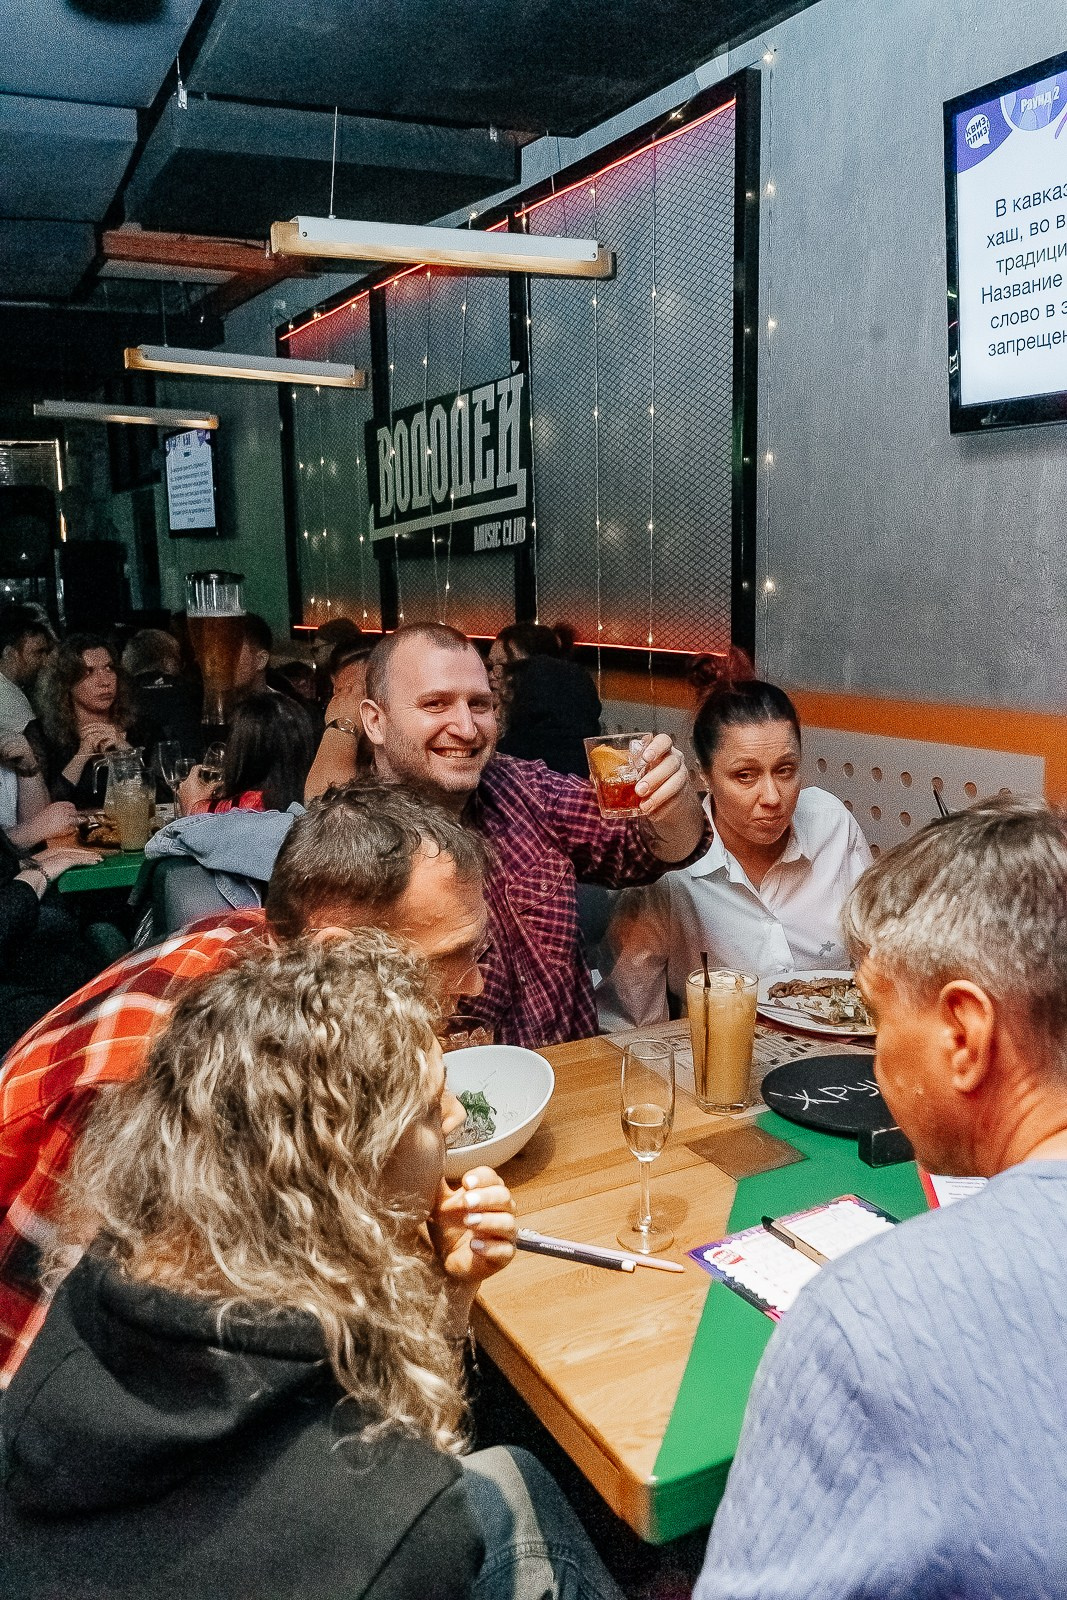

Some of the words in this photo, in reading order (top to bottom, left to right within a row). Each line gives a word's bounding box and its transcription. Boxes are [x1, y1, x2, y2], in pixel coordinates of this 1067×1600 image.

[1052, 85, 1060, 101] 2
[966, 116, 987, 138] КВИЗ
[995, 198, 1007, 218] В
[986, 227, 1023, 249] хаш,
[1029, 218, 1050, 237] во
[995, 242, 1067, 276] традици
[981, 273, 1063, 305] Название
[990, 307, 1040, 329] слово
[1046, 303, 1056, 318] в
[376, 360, 526, 518] ВОДОЛЕЙ
[473, 521, 502, 552] MUSIC
[502, 516, 527, 547] CLUB
